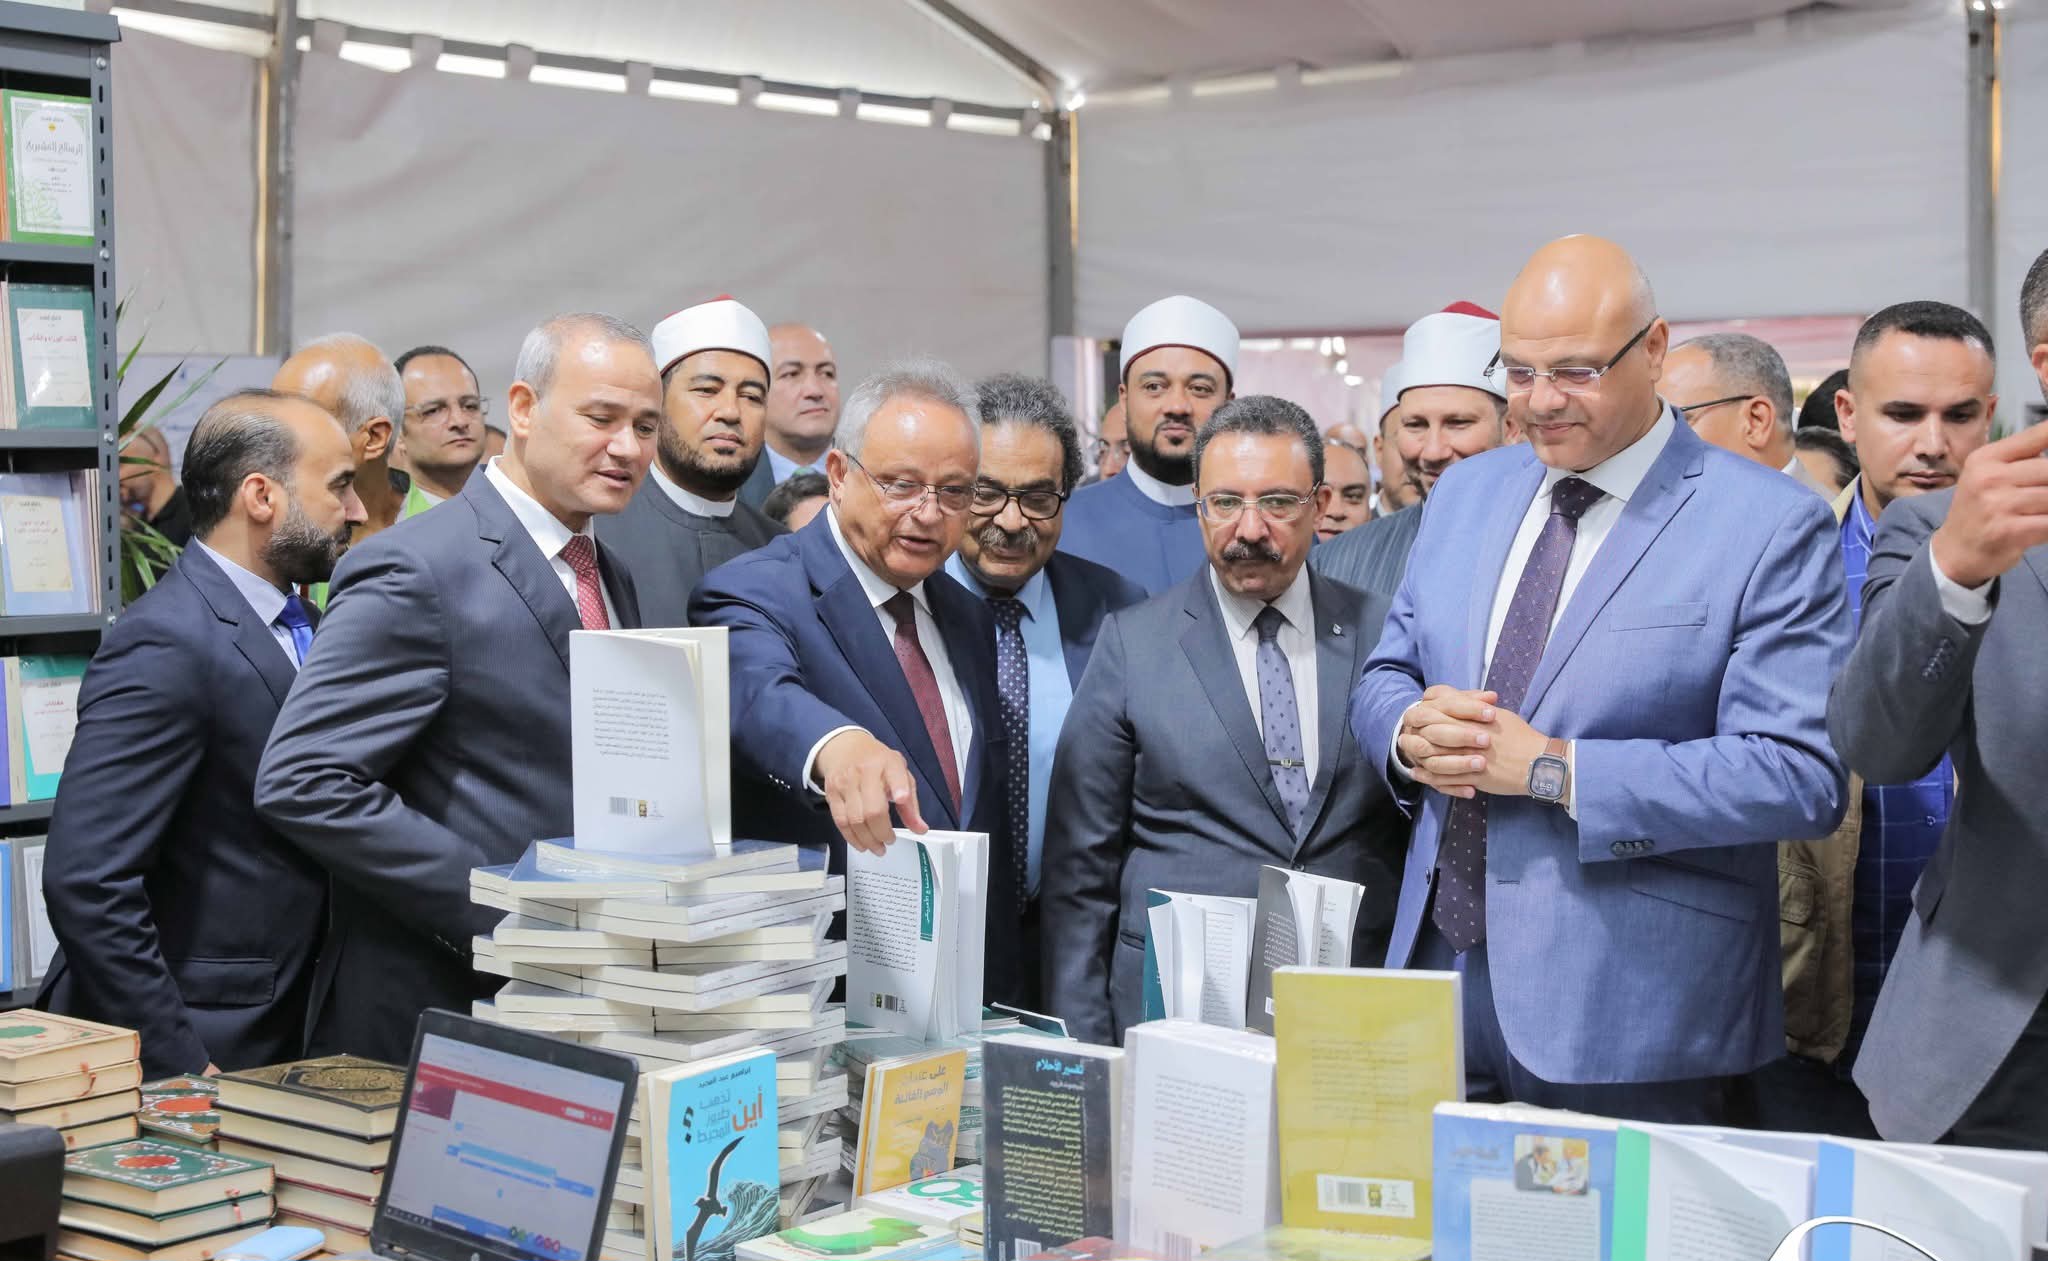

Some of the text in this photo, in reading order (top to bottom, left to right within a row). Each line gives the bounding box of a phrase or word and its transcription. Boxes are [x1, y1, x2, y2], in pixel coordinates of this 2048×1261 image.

[1035, 1058, 1084, 1076] تفسير الأحلام
[699, 1088, 731, 1110] تذهب
[732, 1084, 763, 1132] أين
[706, 1105, 731, 1129] طيور
[697, 1120, 731, 1144] المحيط
